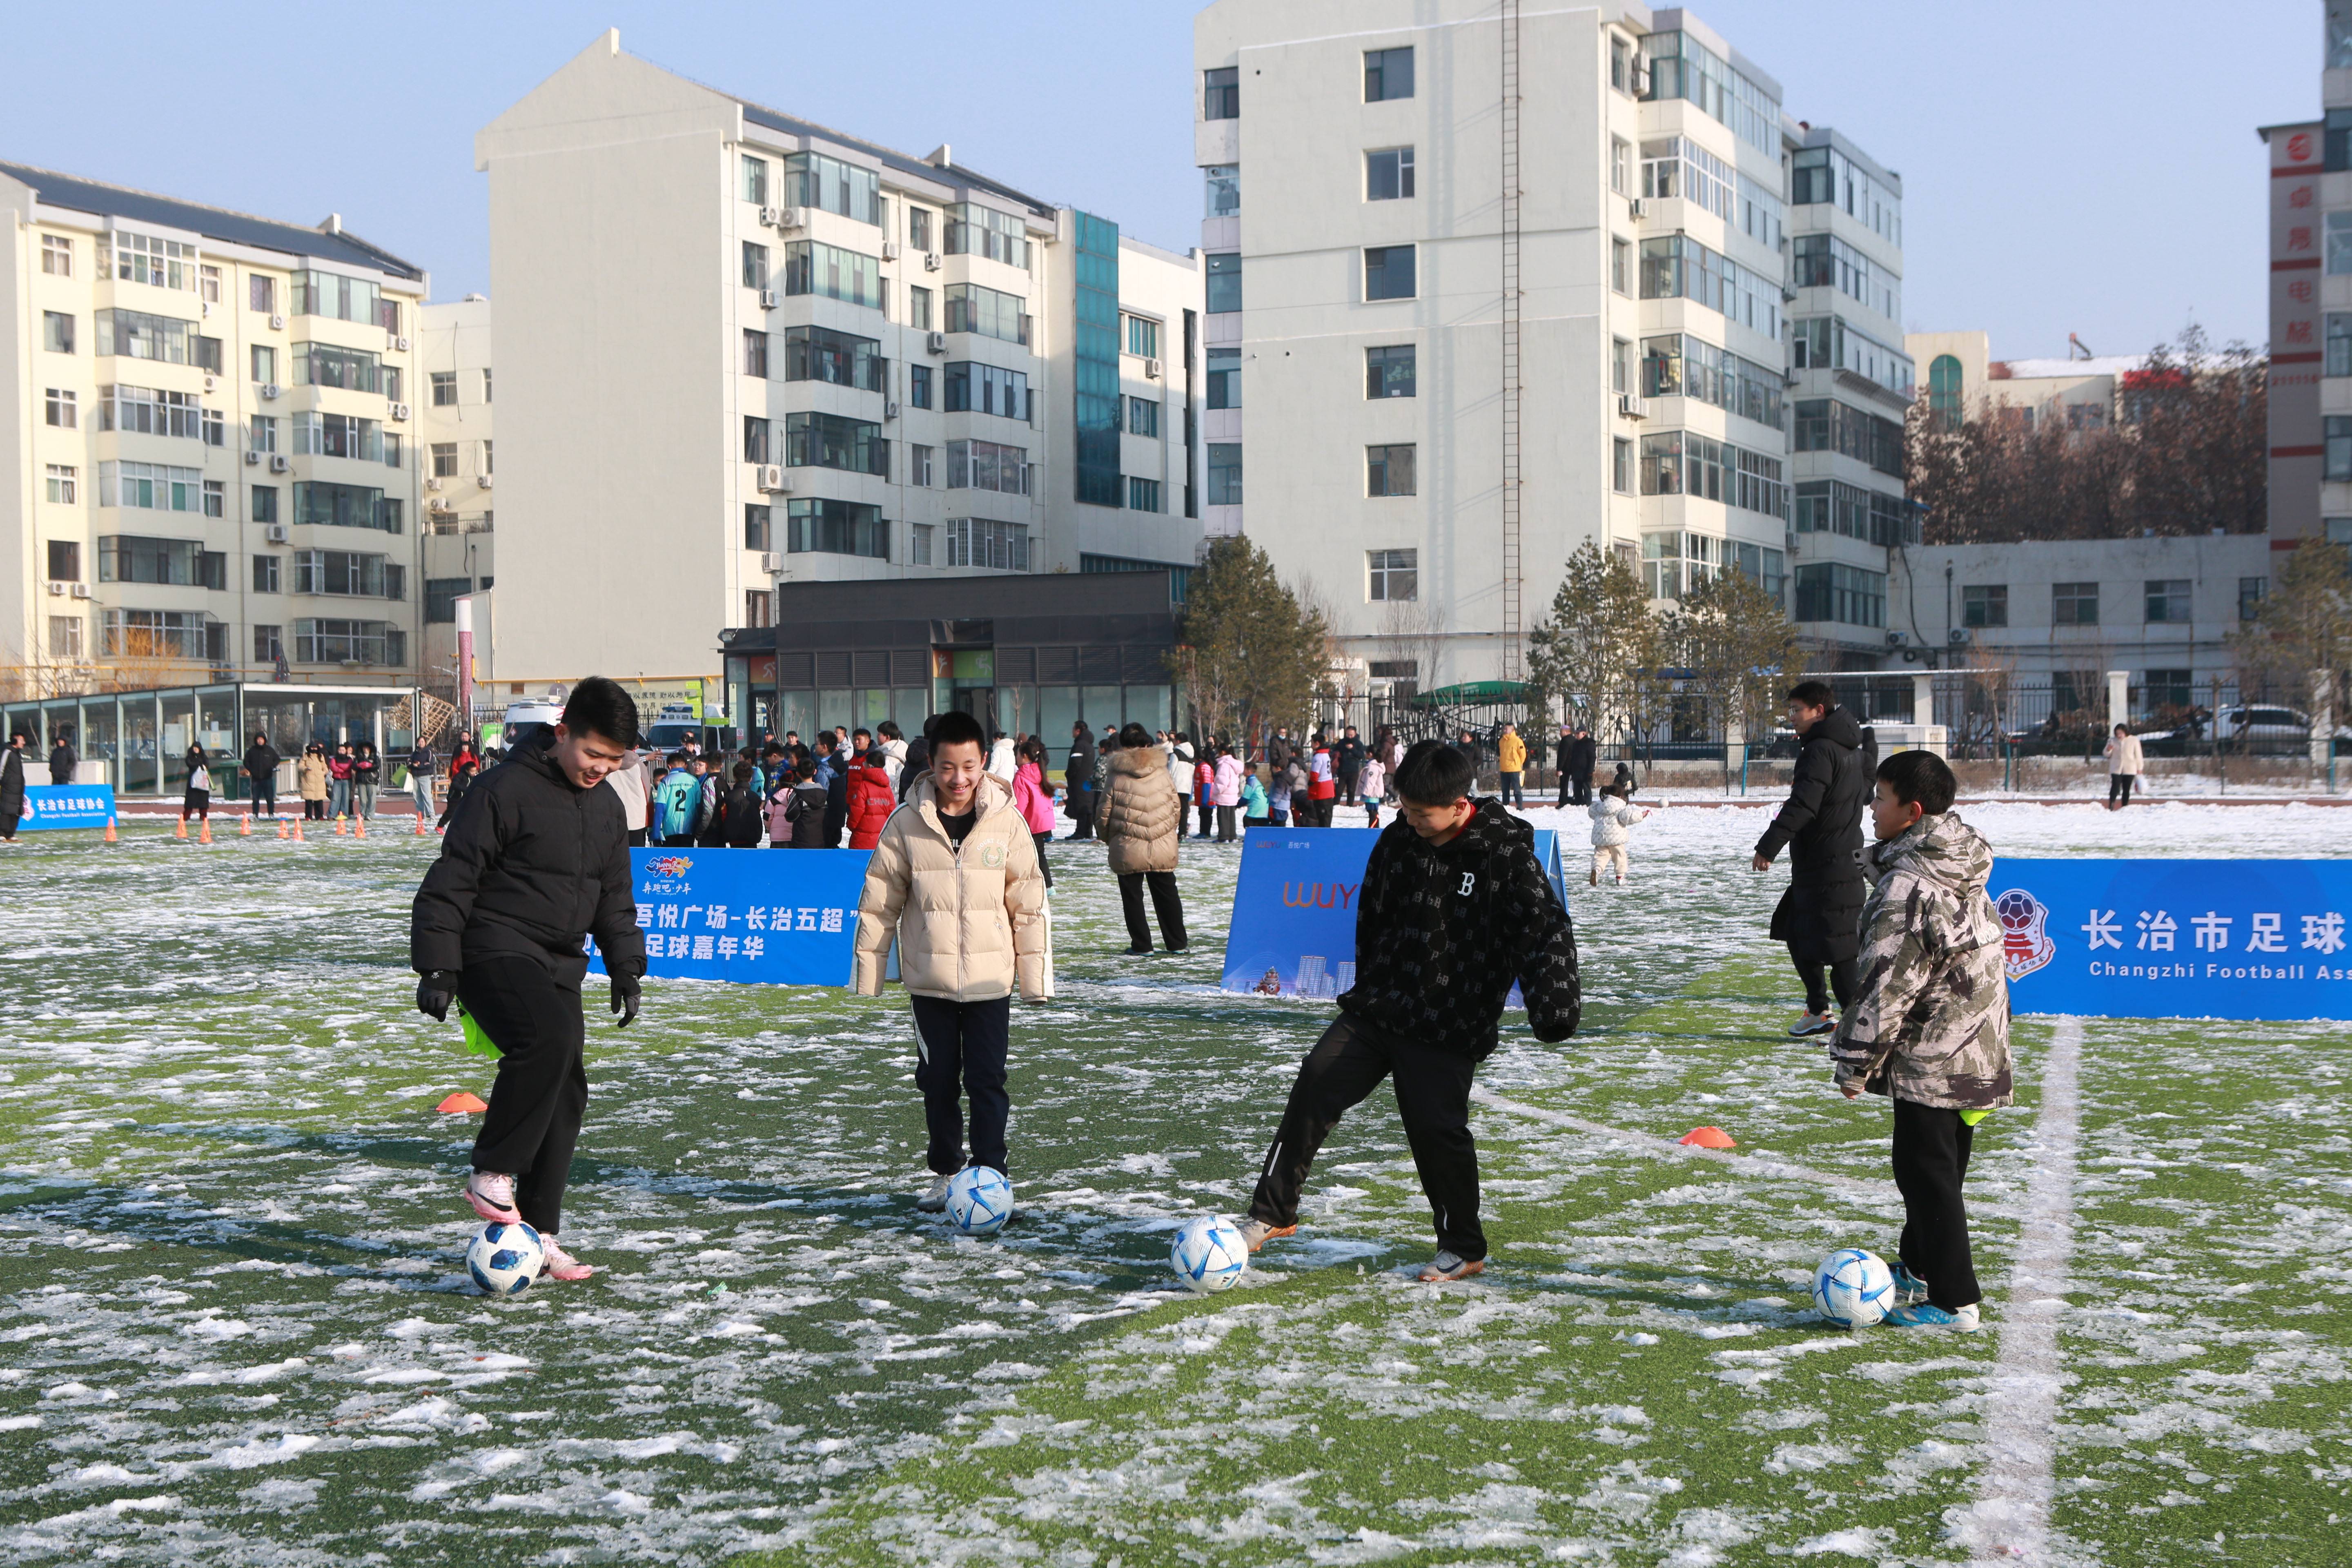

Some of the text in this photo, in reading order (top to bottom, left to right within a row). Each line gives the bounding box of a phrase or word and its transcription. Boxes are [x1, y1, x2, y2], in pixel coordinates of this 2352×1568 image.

[37, 797, 105, 811] 长治市足球协会
[675, 789, 686, 812] 2
[976, 838, 994, 851] COURT
[1457, 872, 1475, 896] B
[2081, 909, 2347, 955] 长治市足球
[2089, 961, 2194, 980] Changzhi
[2207, 964, 2304, 979] Football
